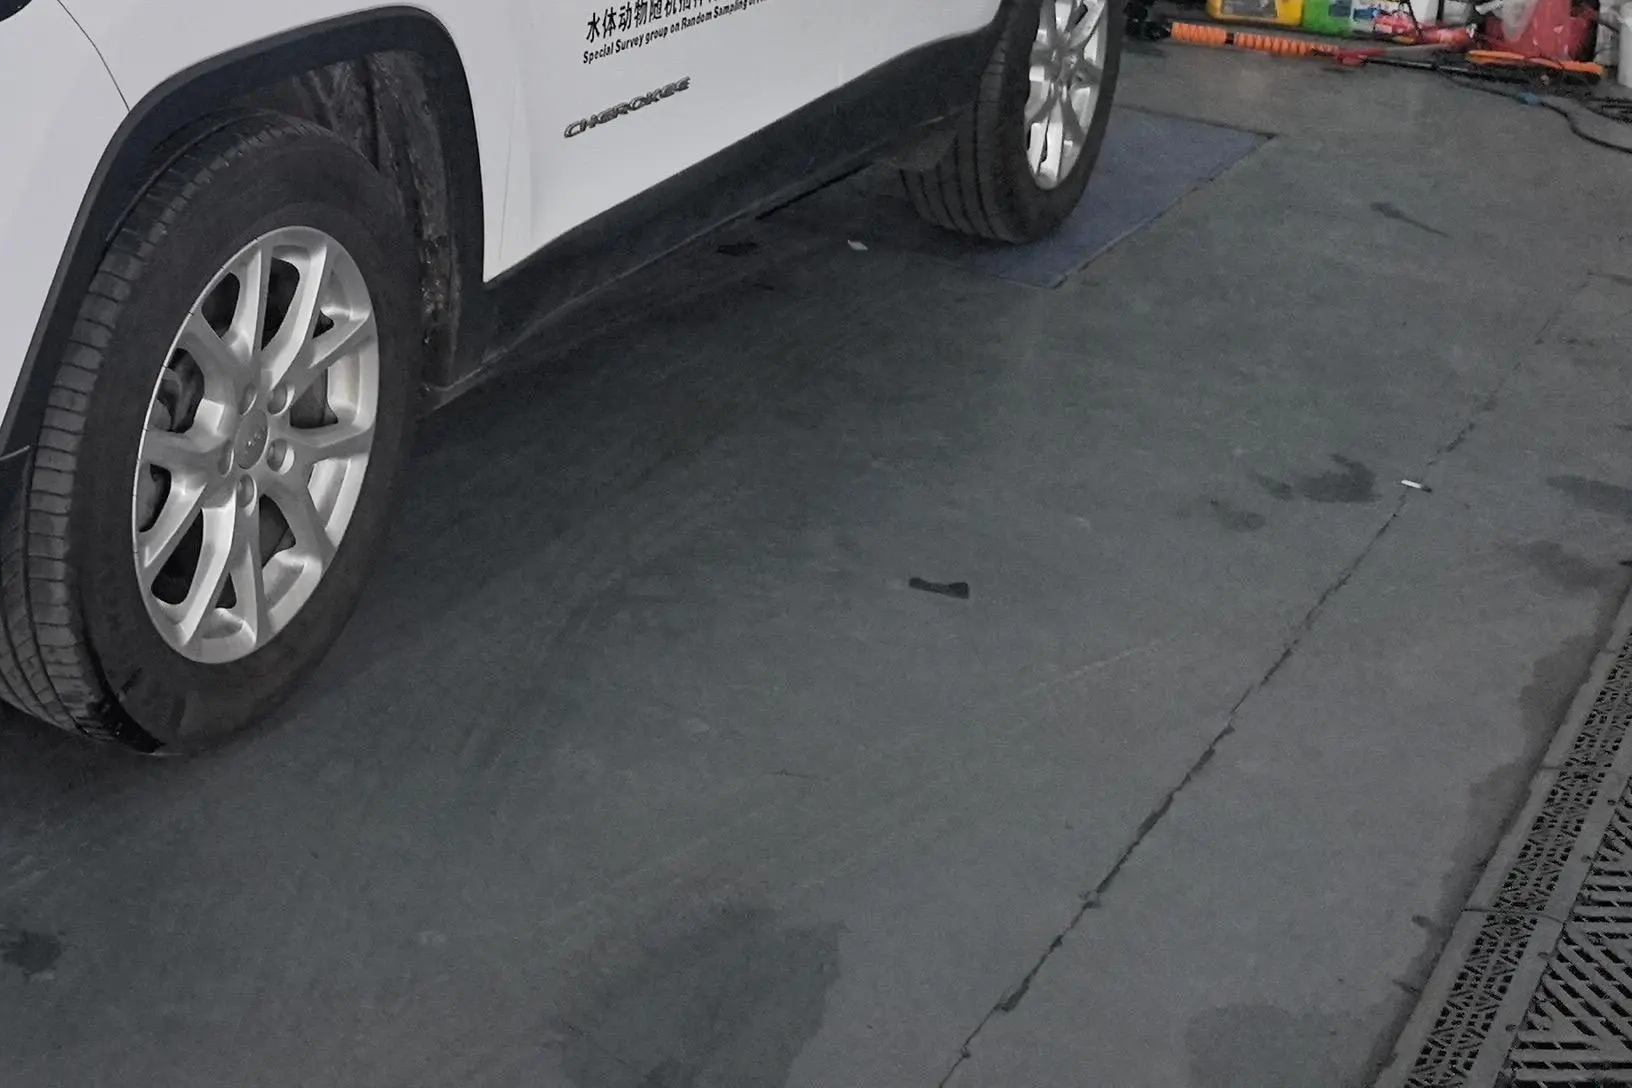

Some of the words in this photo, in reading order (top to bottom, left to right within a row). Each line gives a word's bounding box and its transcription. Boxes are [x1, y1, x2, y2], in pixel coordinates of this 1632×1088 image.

[583, 42, 614, 64] Special
[615, 33, 645, 54] Survey
[645, 26, 668, 44] group
[670, 22, 680, 33] on
[681, 11, 712, 30] Random
[564, 76, 691, 138] CHEROKEE
